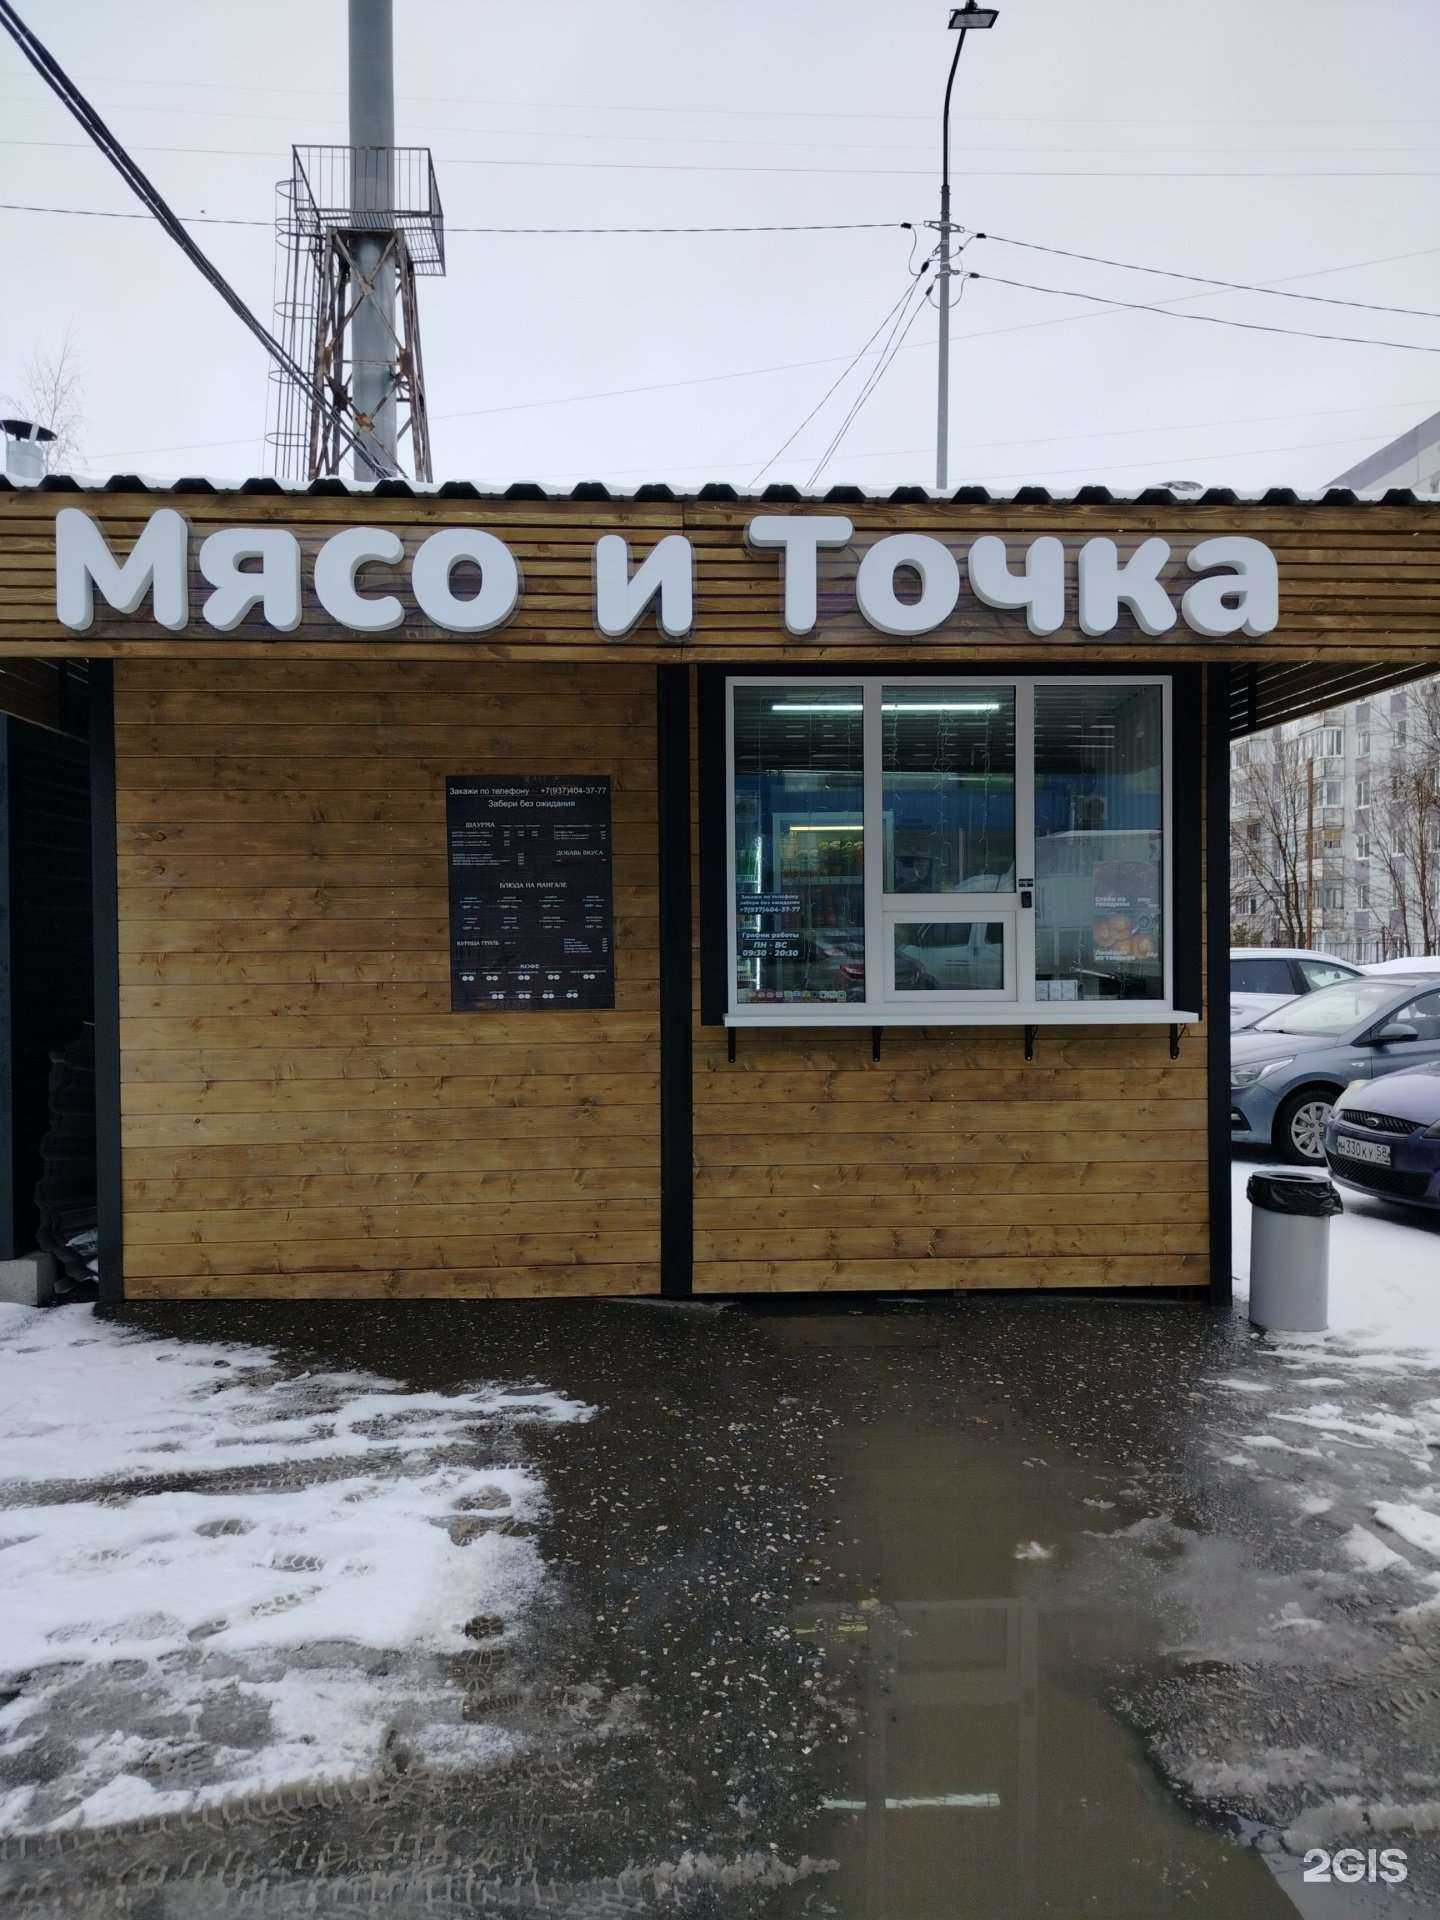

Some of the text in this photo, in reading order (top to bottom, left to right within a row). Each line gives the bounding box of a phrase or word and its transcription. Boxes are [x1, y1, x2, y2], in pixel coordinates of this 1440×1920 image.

[56, 507, 1280, 637] Мясо и Точка
[449, 787, 479, 796] Закажи
[480, 788, 490, 796] по
[491, 787, 530, 797] телефону
[487, 799, 576, 809] Забери без ожидания
[465, 821, 496, 829] ШАУРМА
